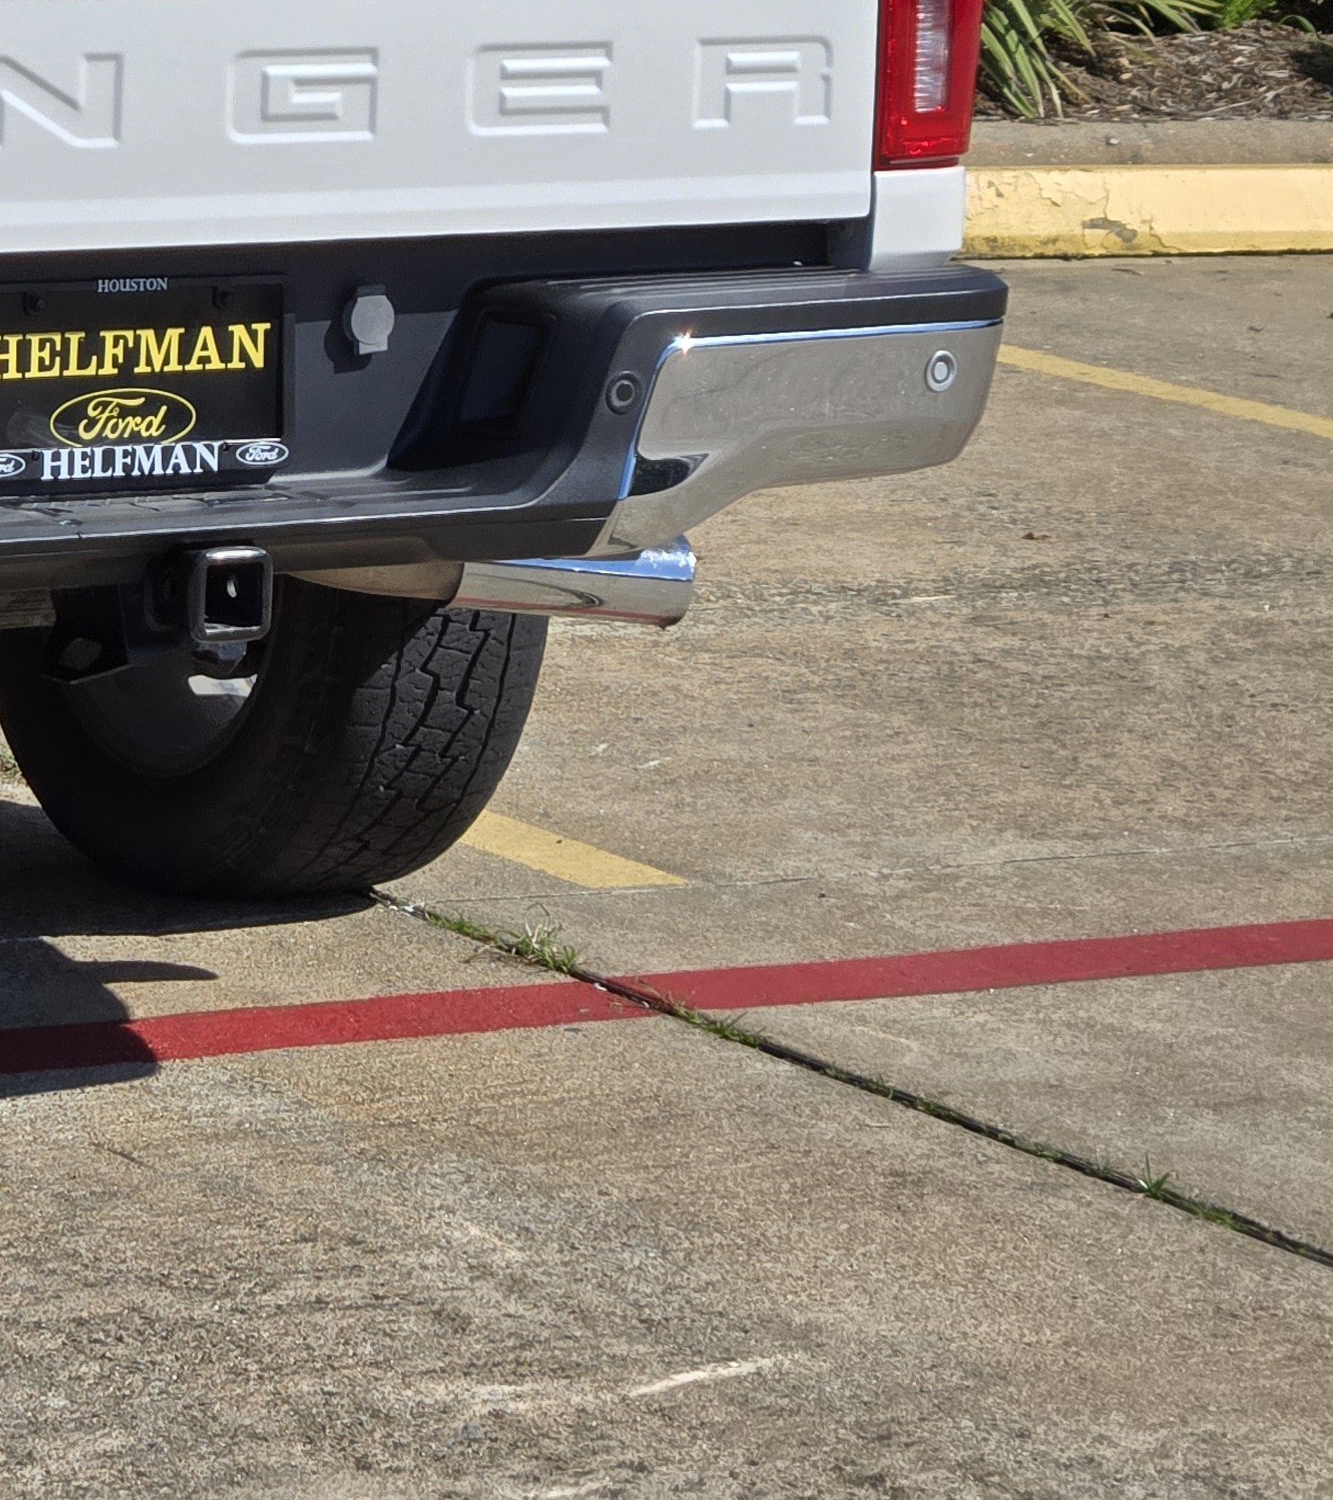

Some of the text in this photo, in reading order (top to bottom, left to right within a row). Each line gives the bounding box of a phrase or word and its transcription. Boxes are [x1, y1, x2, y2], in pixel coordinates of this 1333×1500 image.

[97, 277, 168, 293] HOUSTON
[78, 397, 167, 440] Ford
[41, 442, 222, 481] HELFMAN
[244, 445, 279, 461] Ford
